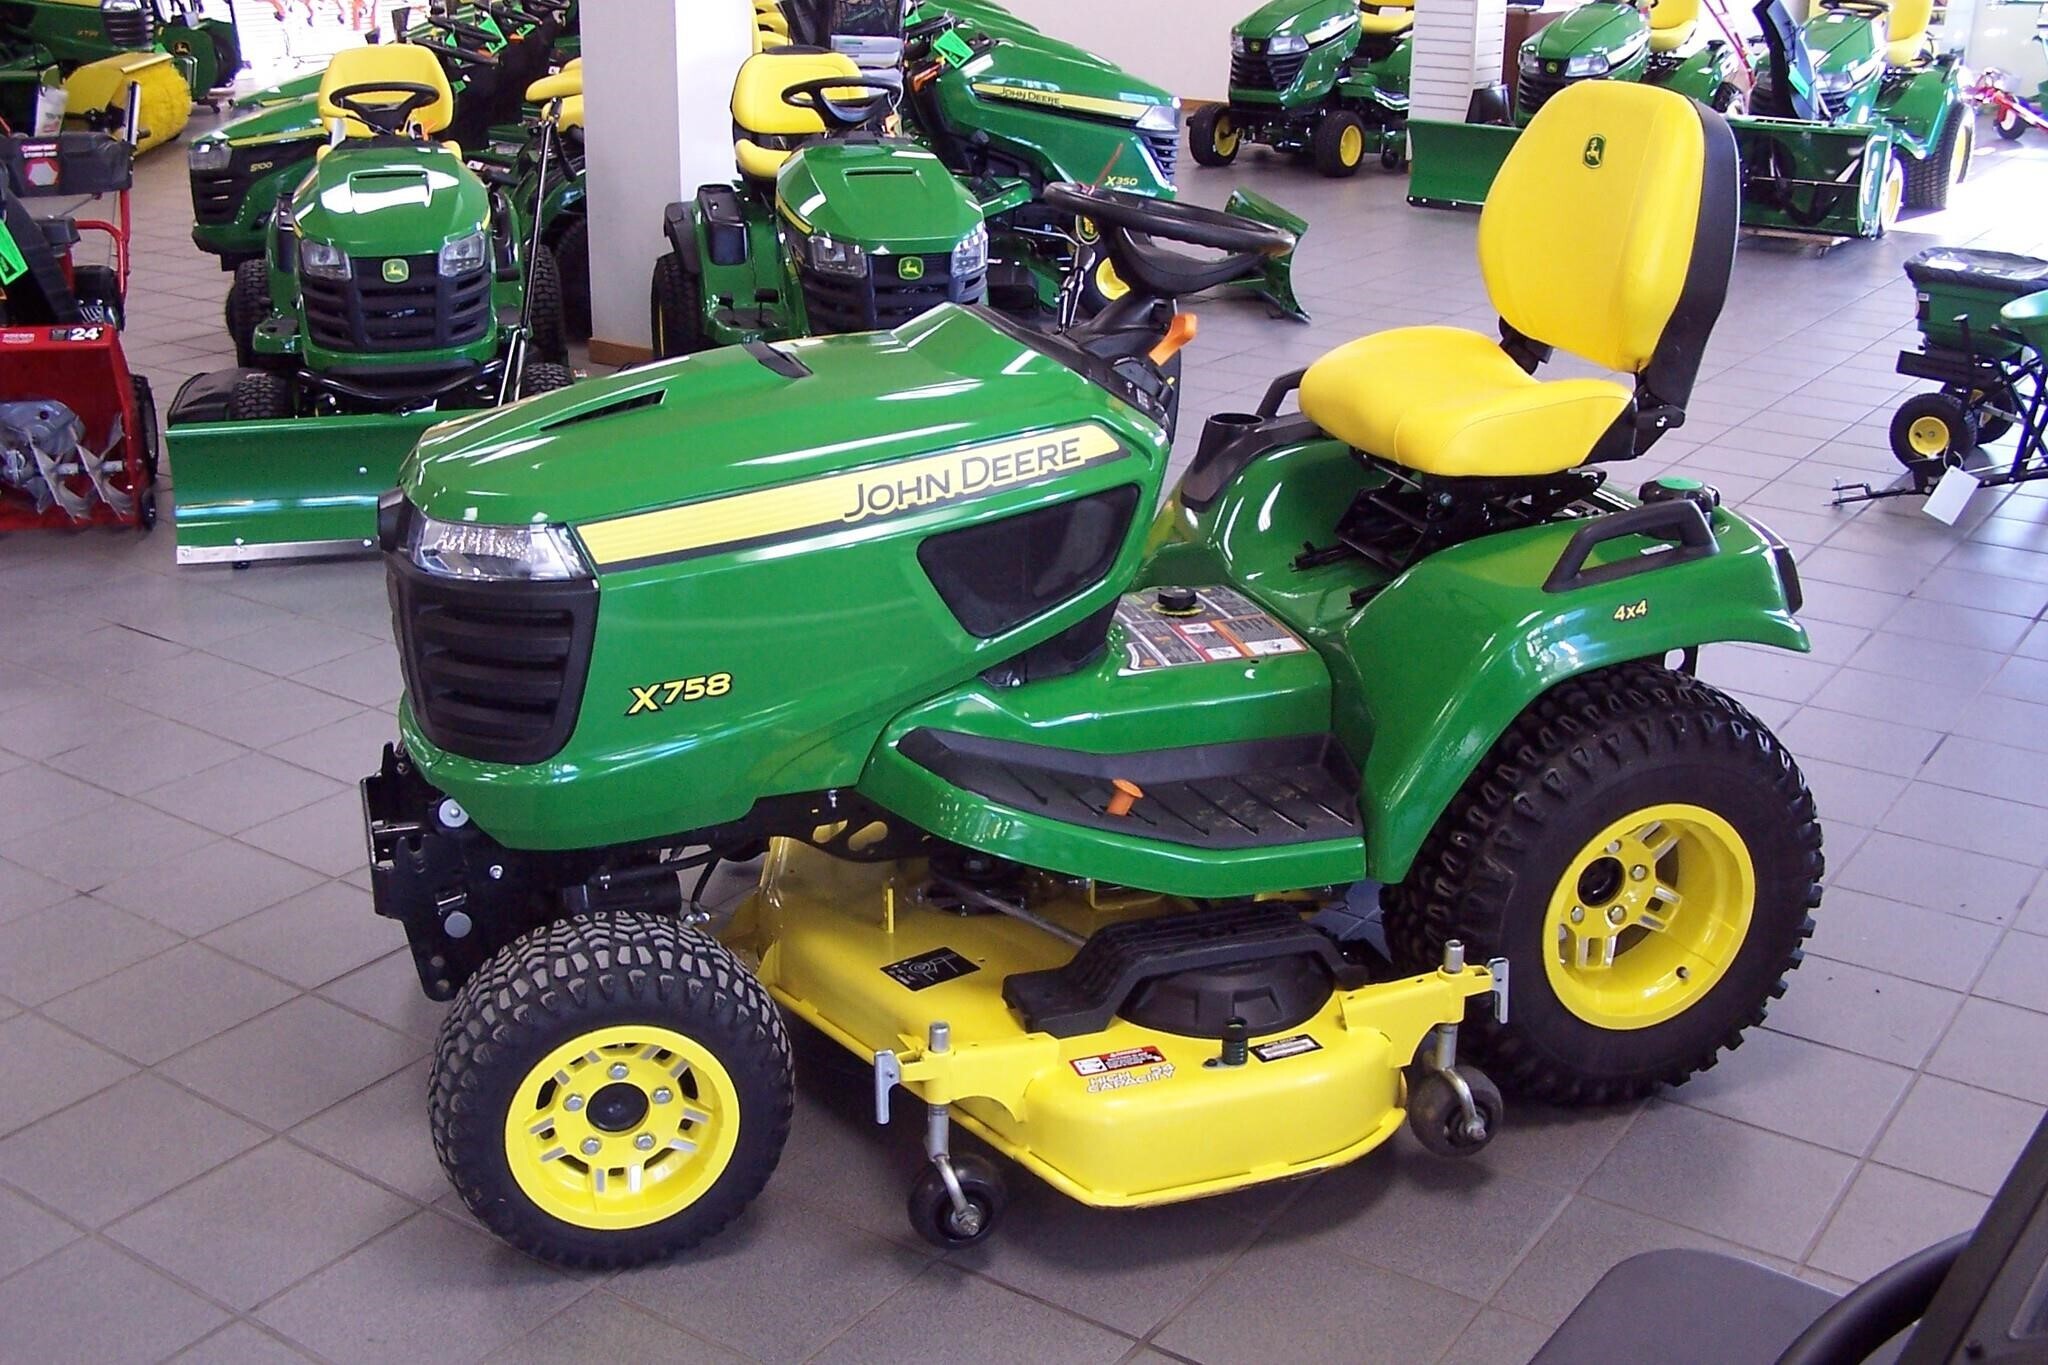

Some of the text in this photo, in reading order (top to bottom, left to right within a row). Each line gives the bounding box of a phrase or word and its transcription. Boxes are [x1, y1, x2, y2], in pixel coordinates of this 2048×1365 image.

[1001, 87, 1026, 99] JOHN
[844, 437, 1082, 518] JOHN DEERE
[1613, 599, 1648, 621] 4x4
[625, 672, 733, 715] X758
